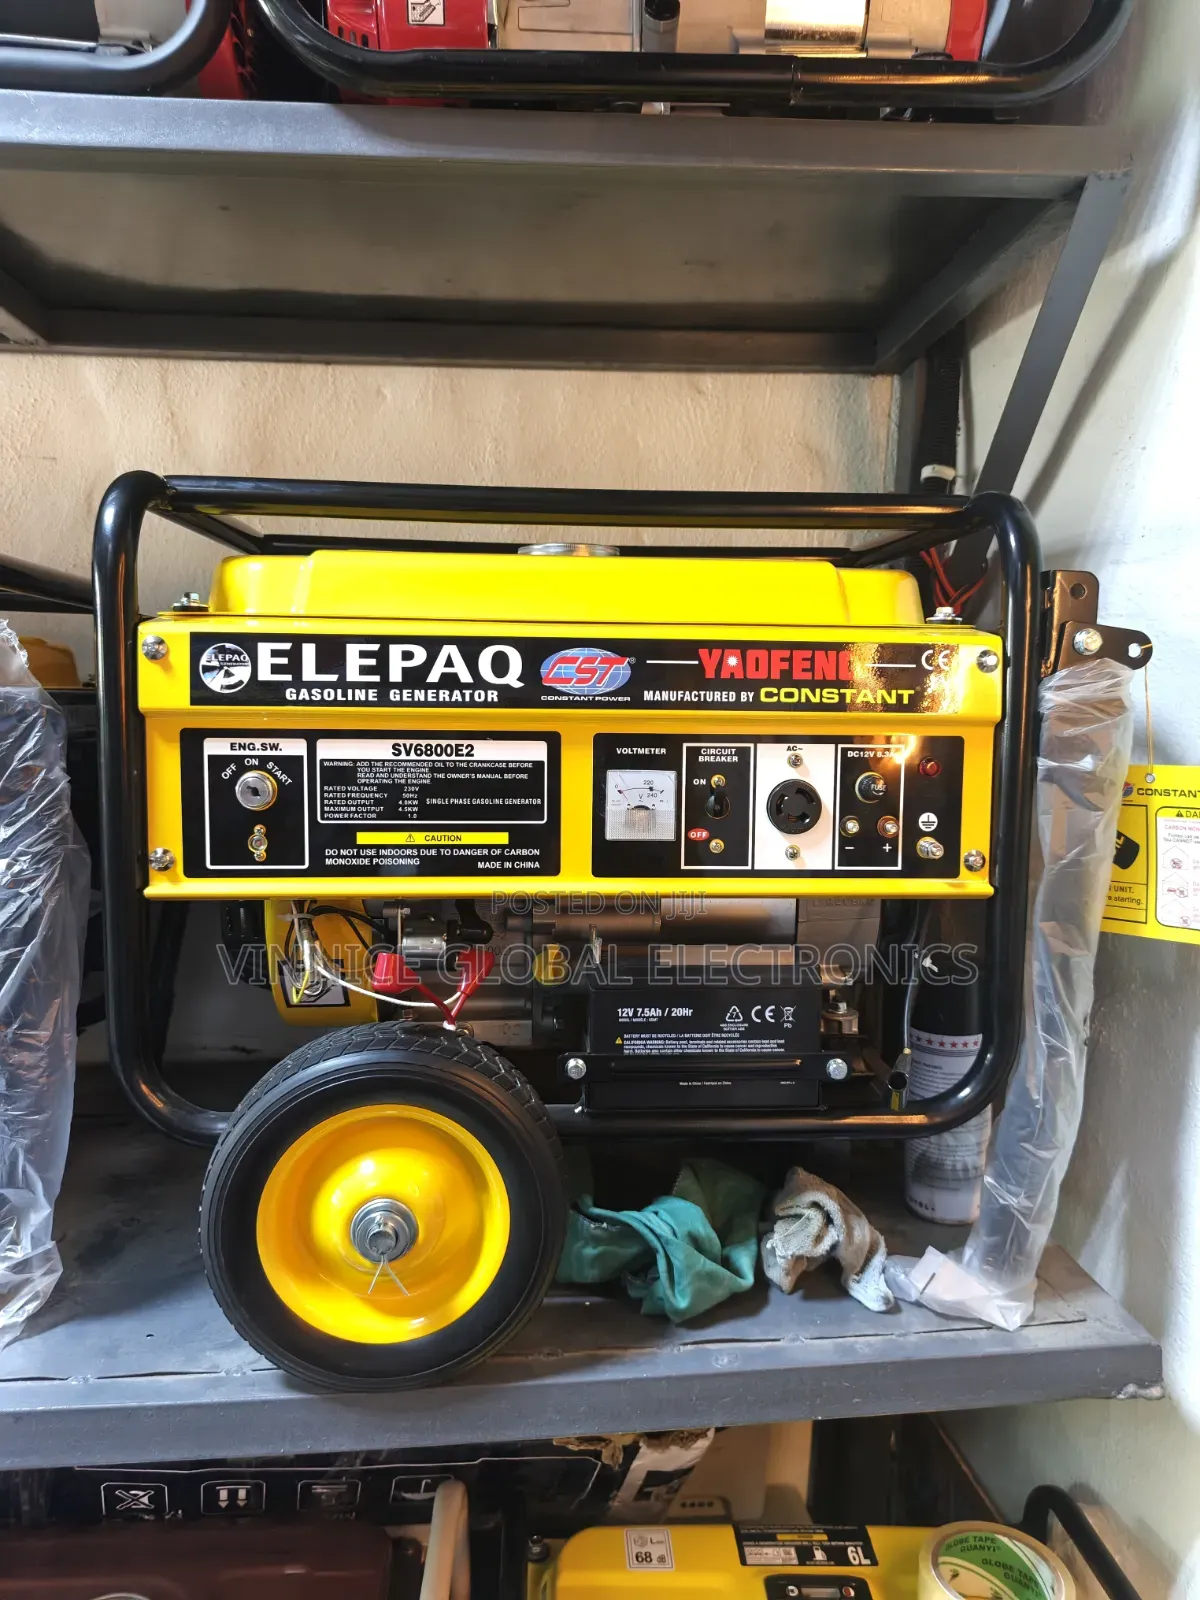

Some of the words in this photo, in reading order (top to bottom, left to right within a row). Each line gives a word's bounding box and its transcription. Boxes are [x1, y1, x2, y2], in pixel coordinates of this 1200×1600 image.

[206, 654, 249, 663] ELEPAQ
[257, 642, 525, 688] ELEPAQ
[285, 688, 378, 701] GASOLINE
[389, 689, 498, 702] GENERATOR
[644, 690, 736, 702] MANUFACTURED
[740, 691, 754, 702] BY
[760, 687, 914, 704] CONSTANT
[230, 742, 282, 751] ENG.SW.
[391, 743, 474, 757] SV6800E2
[221, 762, 237, 780] OFF
[266, 762, 292, 786] START
[617, 1008, 634, 1017] 12V
[636, 1008, 662, 1017] 7.5Ah
[671, 1008, 693, 1017] 20Hr
[635, 1552, 652, 1563] 68
[847, 1546, 871, 1565] 6L
[982, 1558, 1014, 1572] GLOBE
